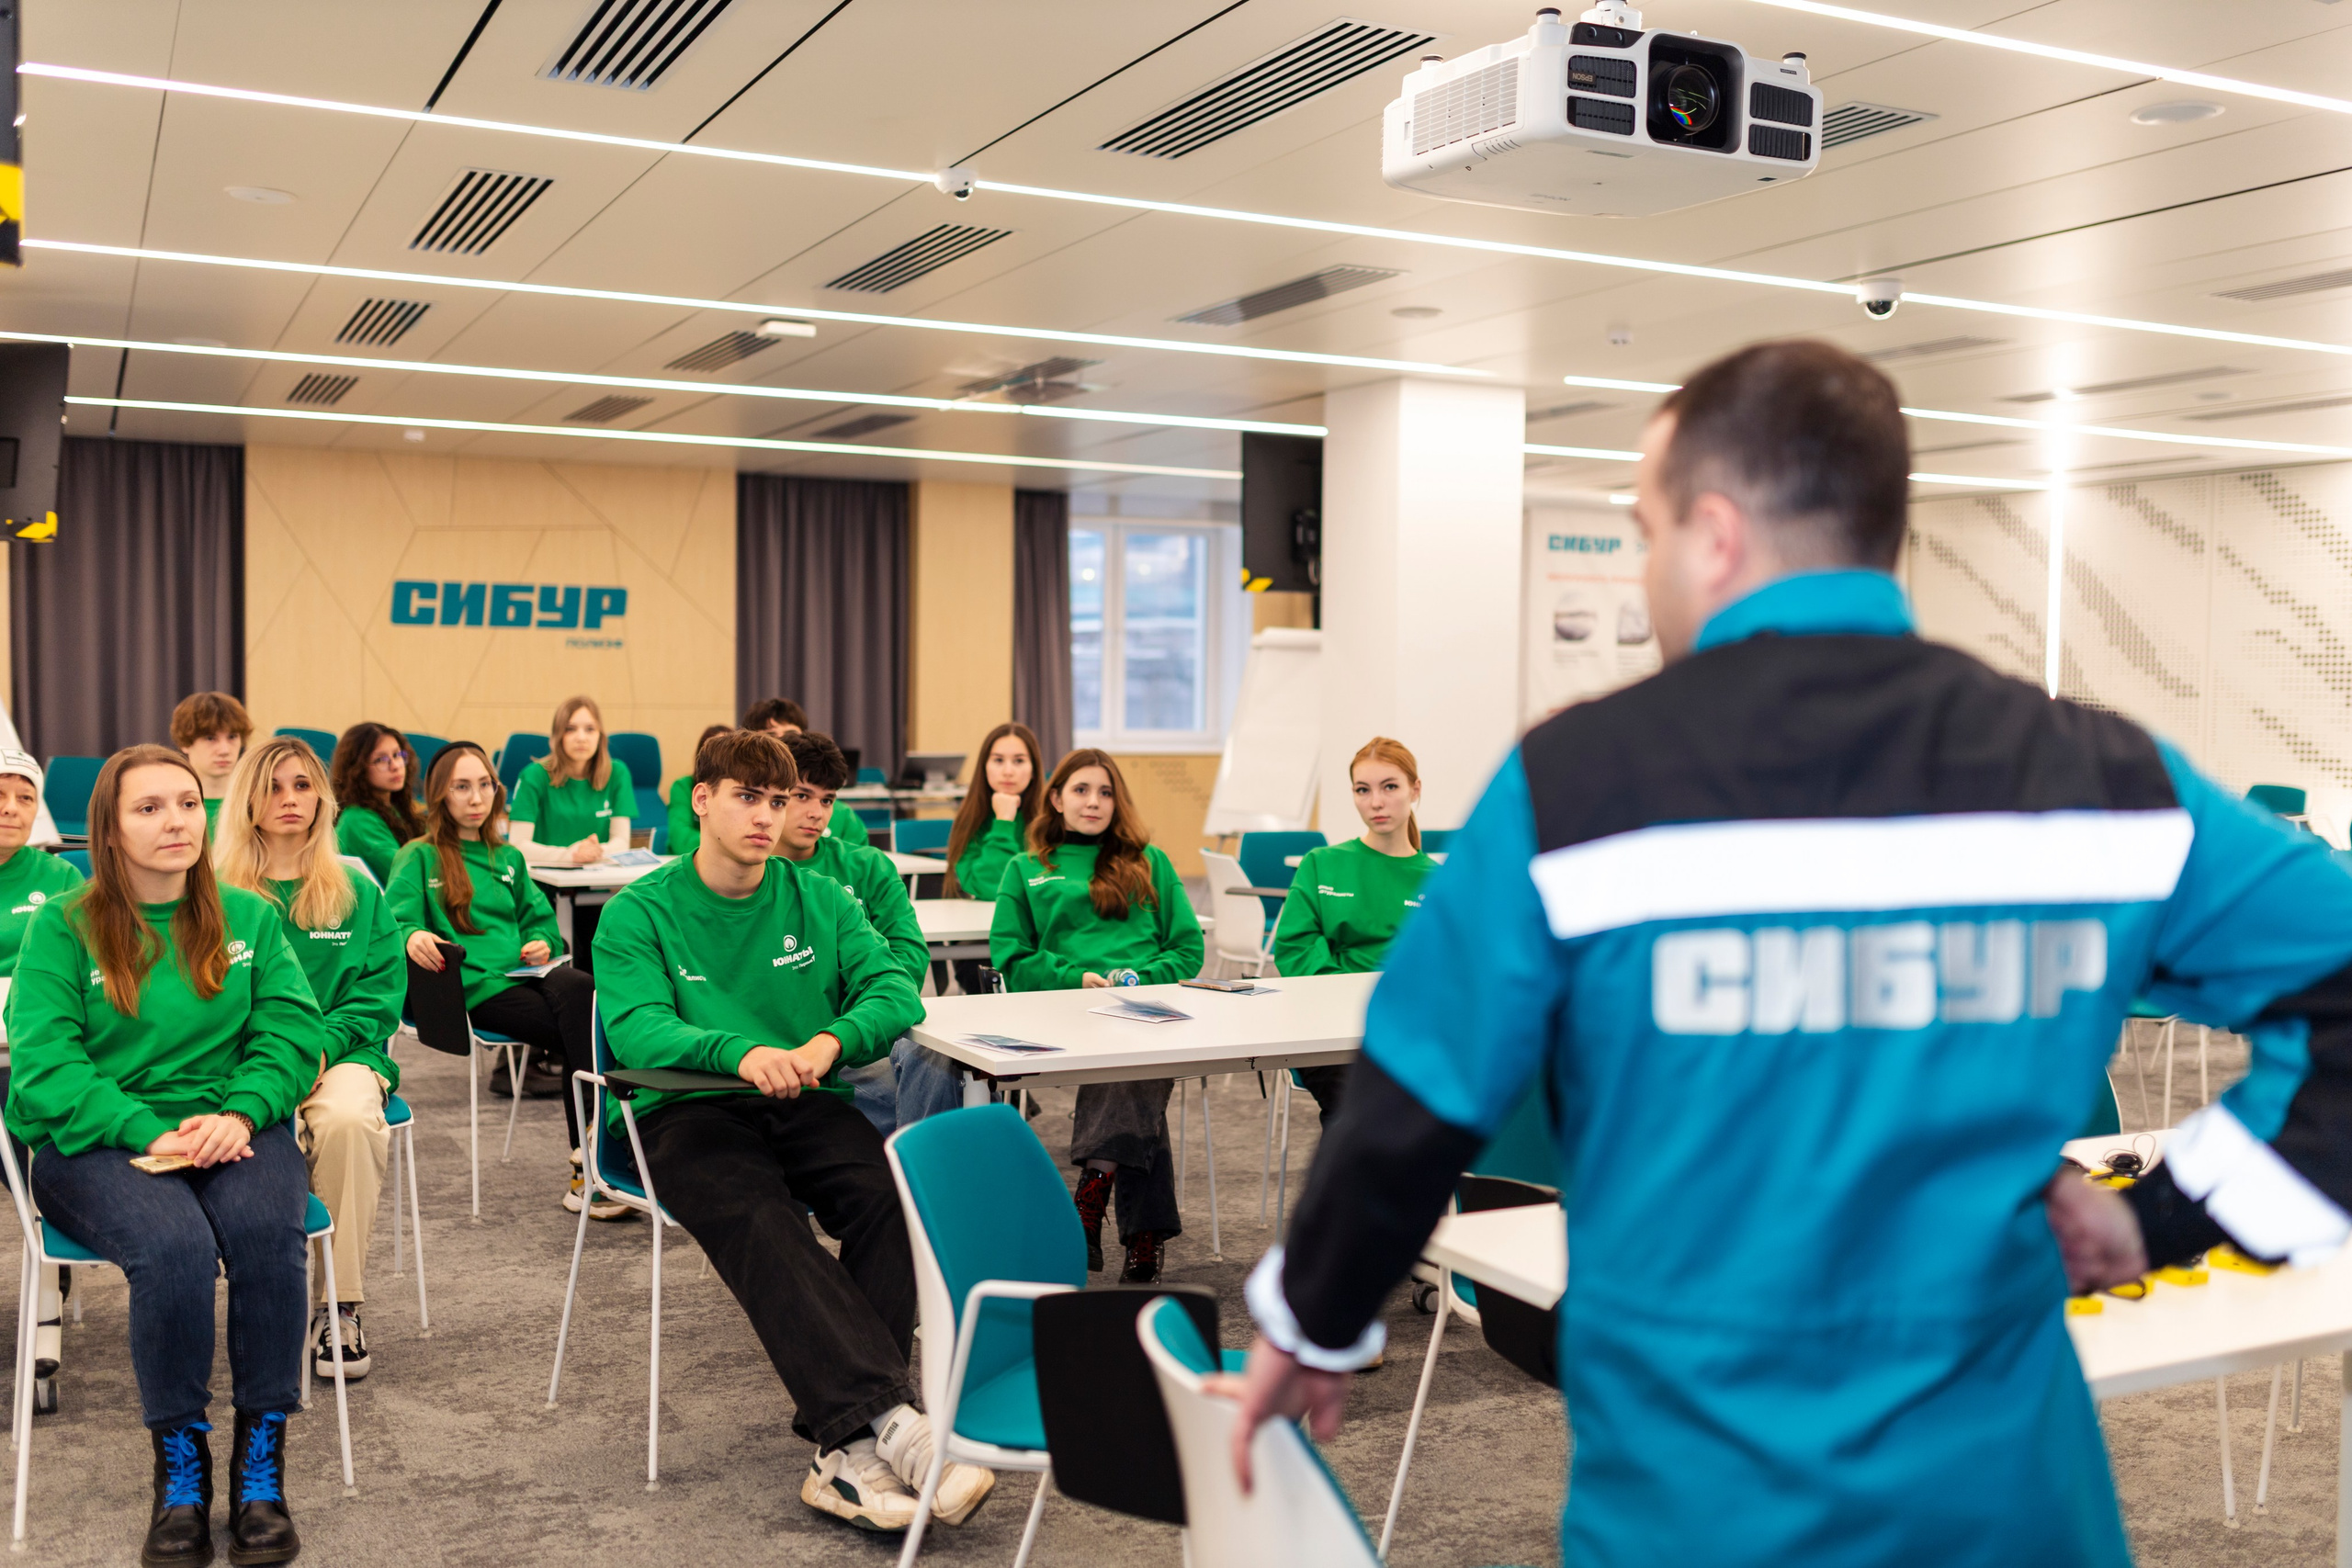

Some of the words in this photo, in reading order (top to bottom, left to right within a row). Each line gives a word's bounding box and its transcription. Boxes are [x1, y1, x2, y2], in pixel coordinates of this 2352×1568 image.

[1572, 73, 1593, 83] EPSON
[1548, 535, 1622, 554] СИБУР
[390, 581, 628, 629] СИБУР
[1653, 919, 2108, 1035] СИБУР
[882, 1421, 899, 1445] PUMA
